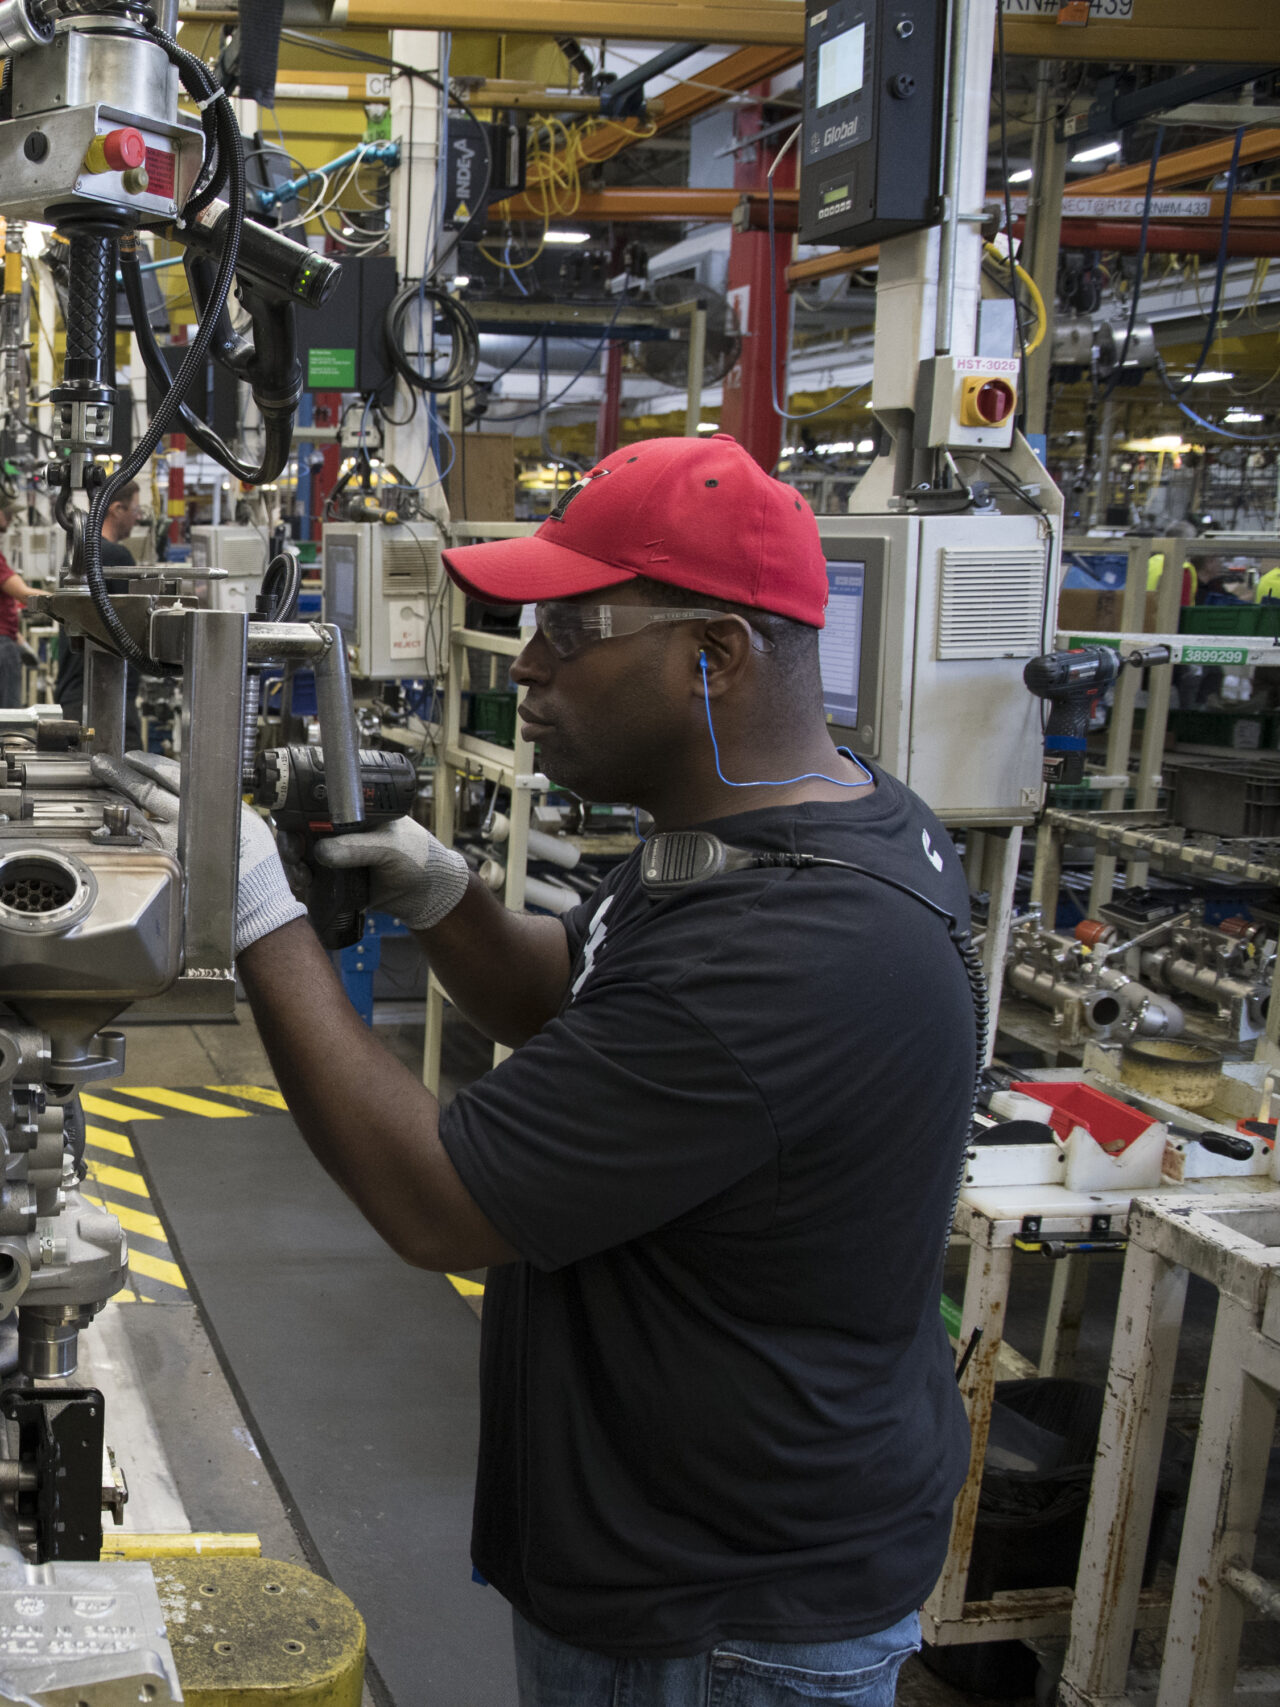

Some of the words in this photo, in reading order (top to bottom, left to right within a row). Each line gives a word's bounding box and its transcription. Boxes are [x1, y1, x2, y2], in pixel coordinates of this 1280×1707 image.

[824, 115, 858, 147] Global
[453, 138, 475, 199] INDEVA
[957, 359, 1016, 371] HST-3026
[1185, 650, 1243, 664] 3899299
